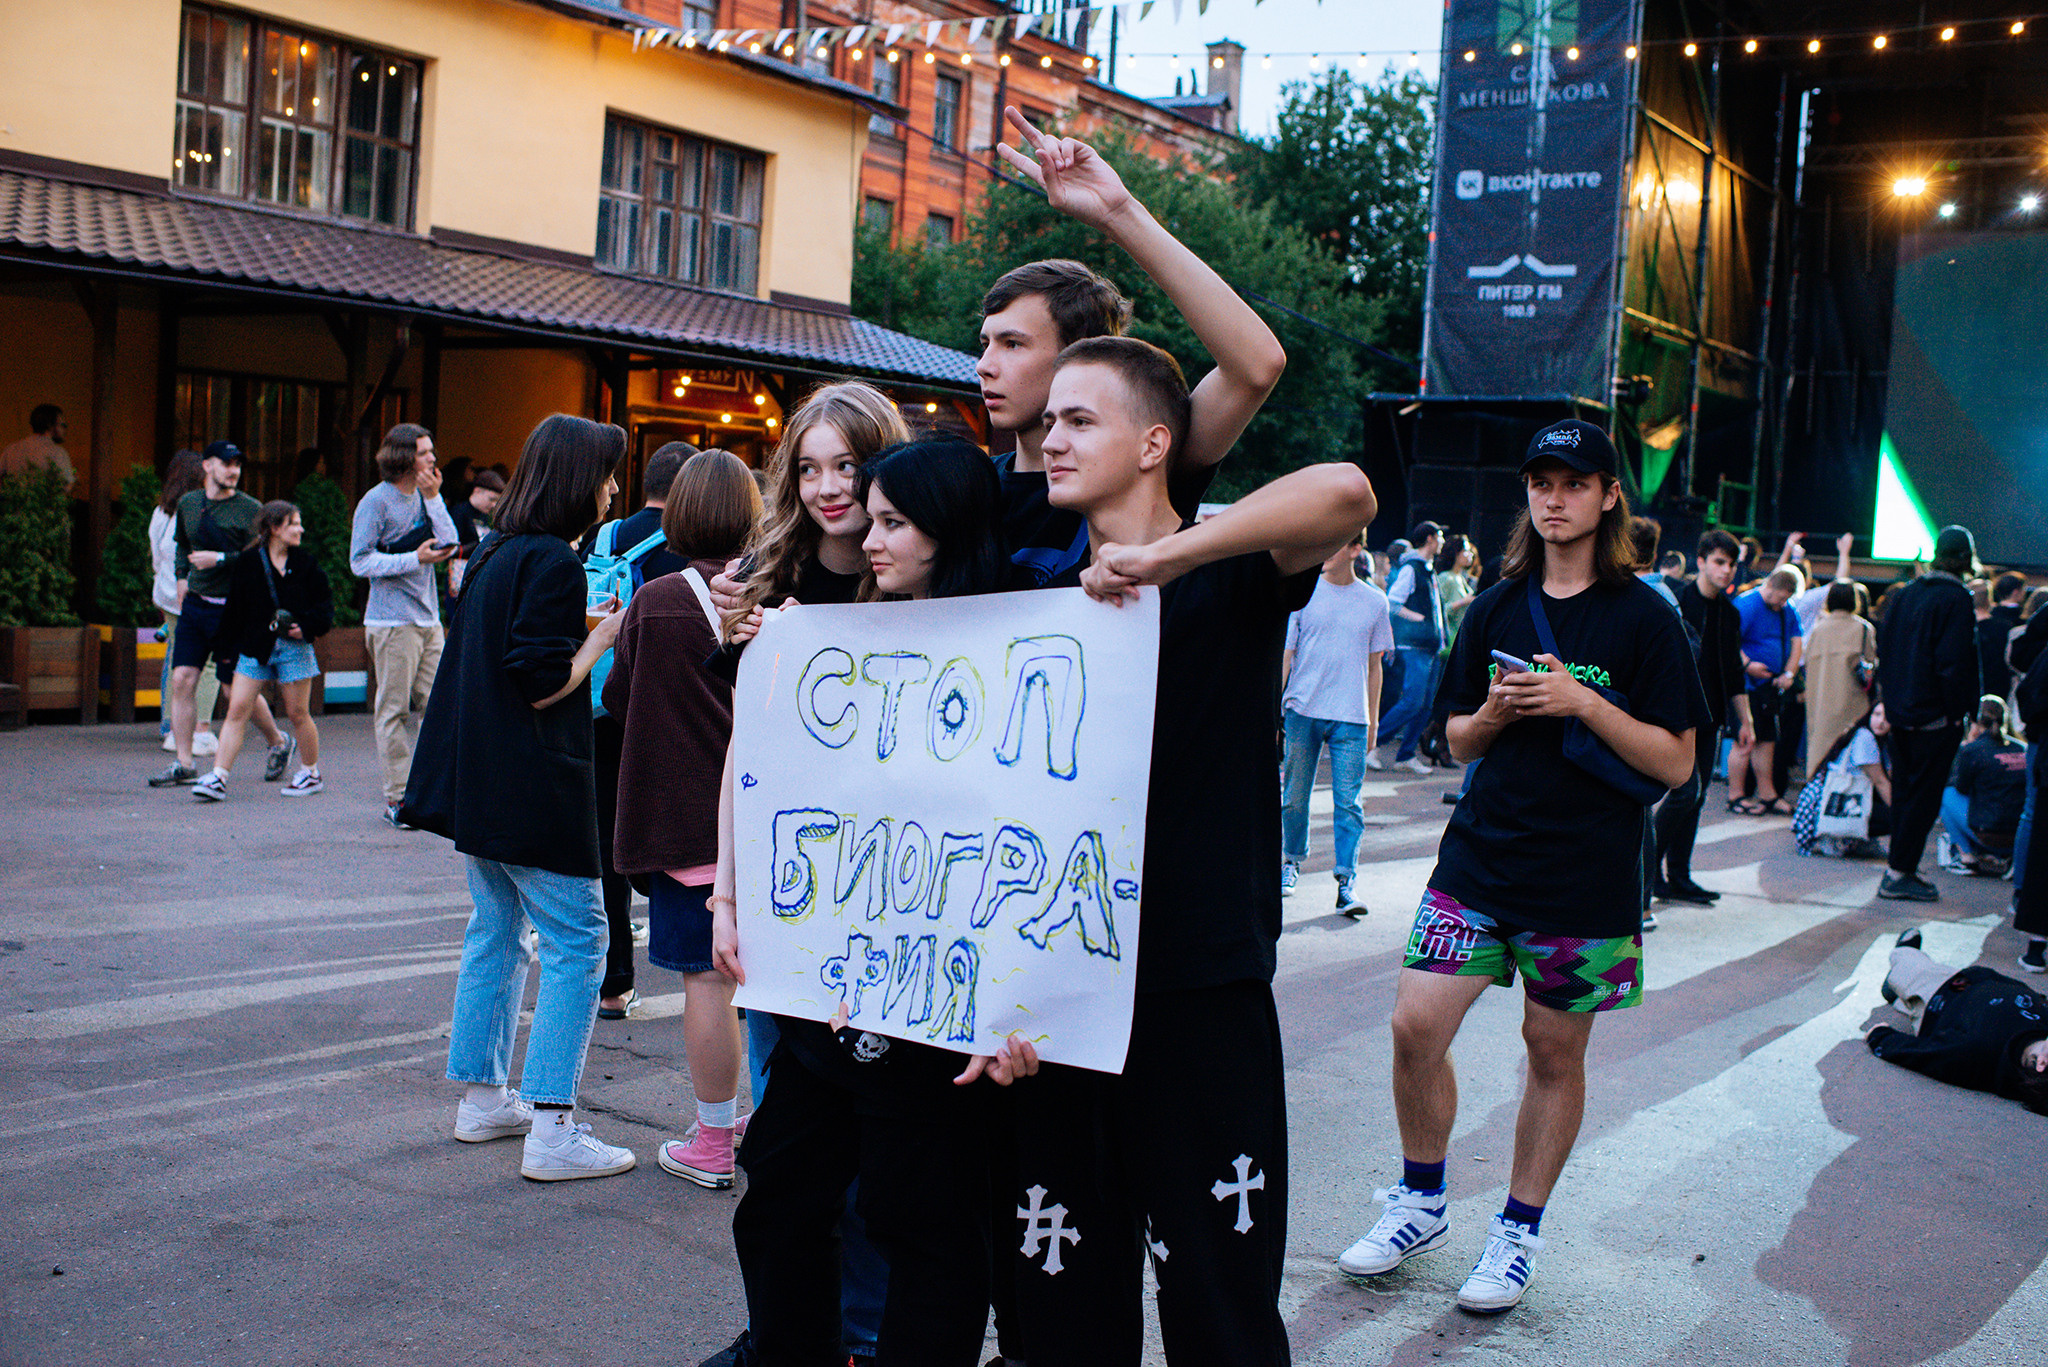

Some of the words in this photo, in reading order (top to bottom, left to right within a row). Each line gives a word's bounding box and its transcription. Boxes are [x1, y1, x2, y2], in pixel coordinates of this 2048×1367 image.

[1458, 82, 1610, 109] МЕНШКОВА
[1477, 284, 1534, 301] ПИТЕР
[1536, 284, 1563, 300] FM
[796, 635, 1086, 781] СТОП
[771, 807, 1139, 960] БИОГРА-
[820, 928, 980, 1043] ФИЯ
